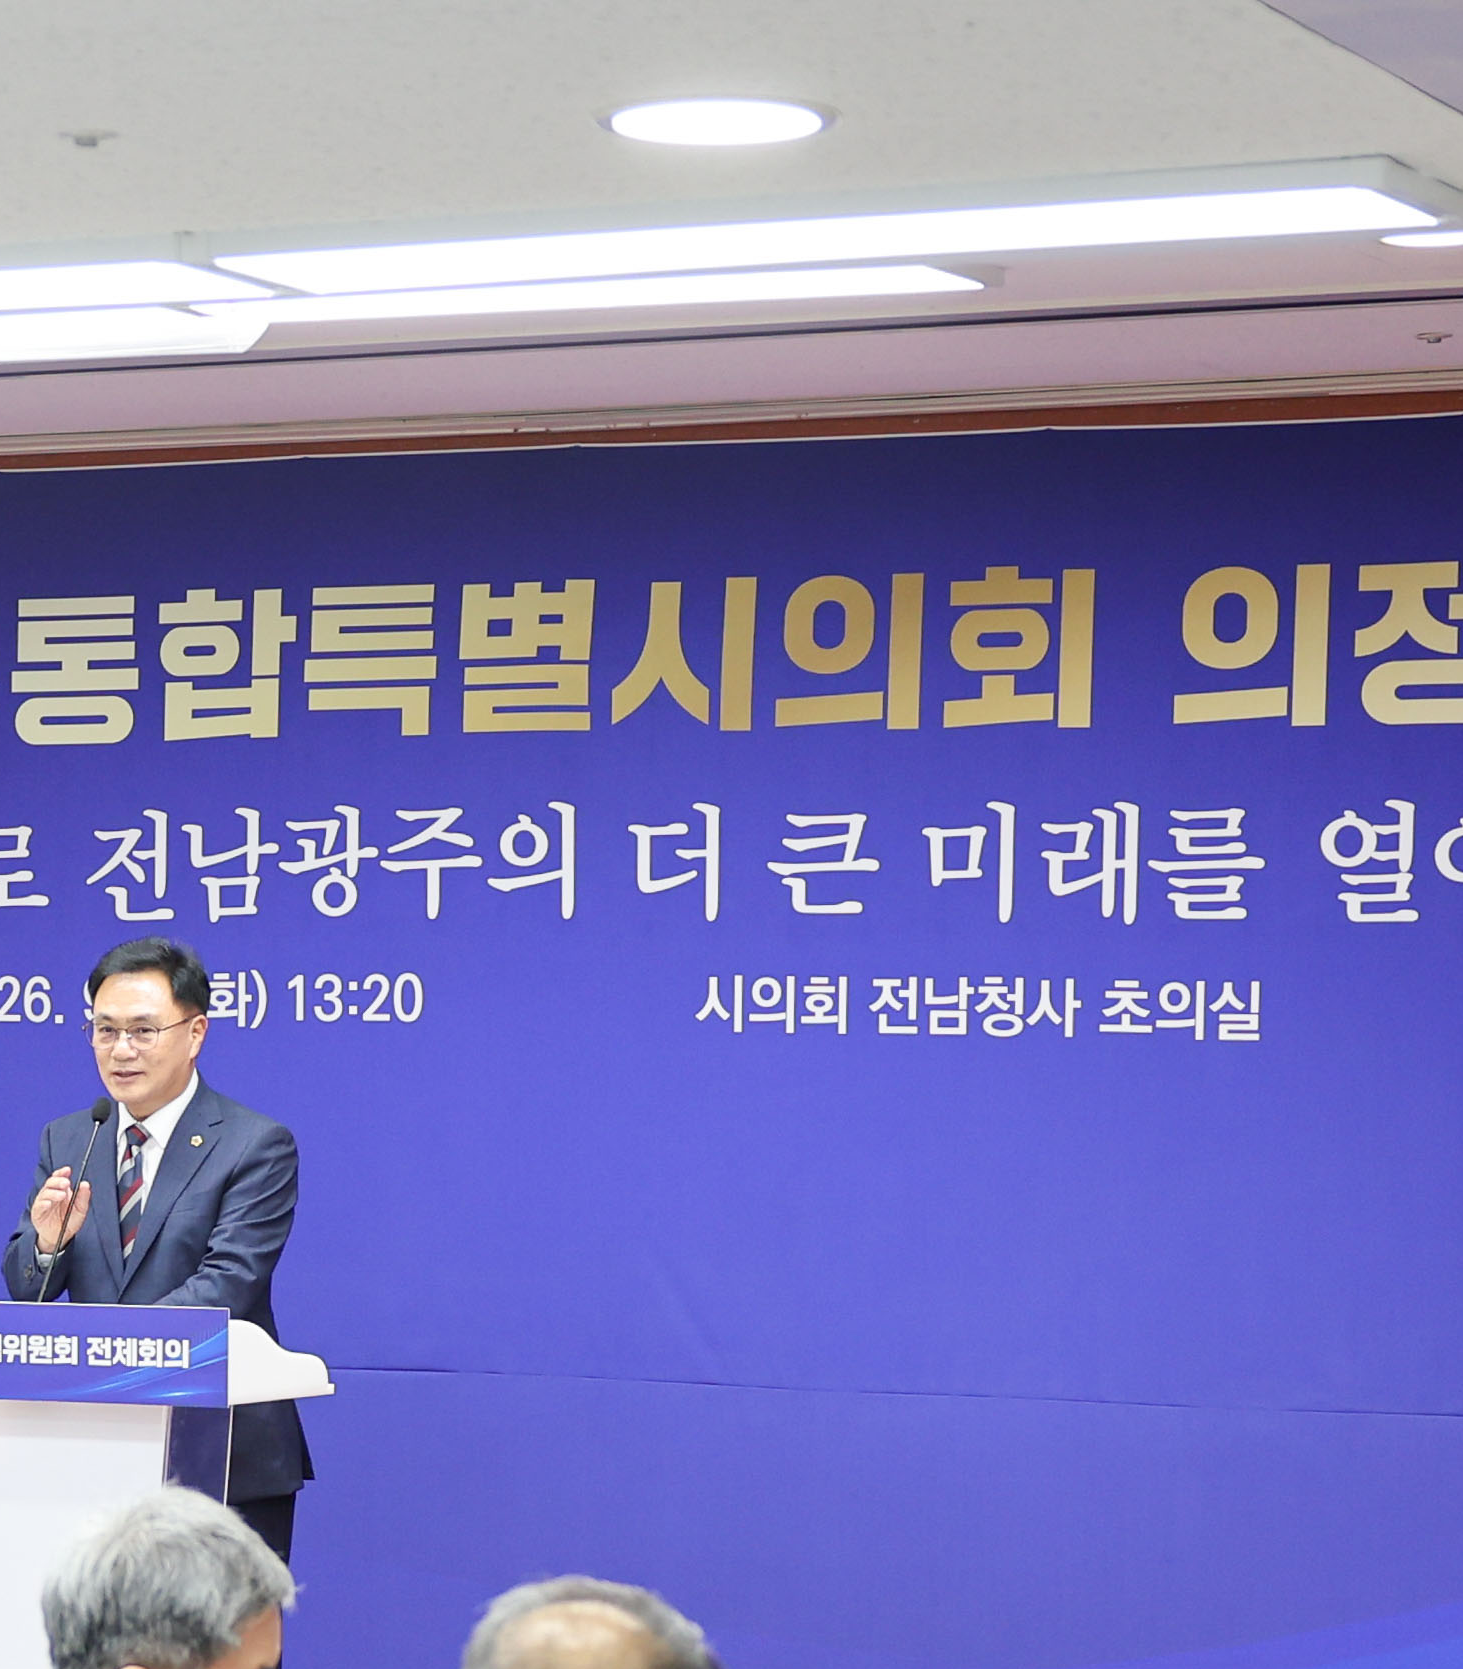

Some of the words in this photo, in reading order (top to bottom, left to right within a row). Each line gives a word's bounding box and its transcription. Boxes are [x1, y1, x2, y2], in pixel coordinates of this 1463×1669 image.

[85, 800, 577, 924] 전남광주의
[626, 801, 722, 923] 더
[765, 812, 881, 915] 큰
[920, 800, 1267, 927] 미래를
[287, 972, 424, 1023] 13:20
[695, 974, 848, 1035] 시의회
[868, 976, 1082, 1038] 전남청사
[1098, 979, 1261, 1041] 초의실
[86, 1336, 191, 1369] 전체회의
